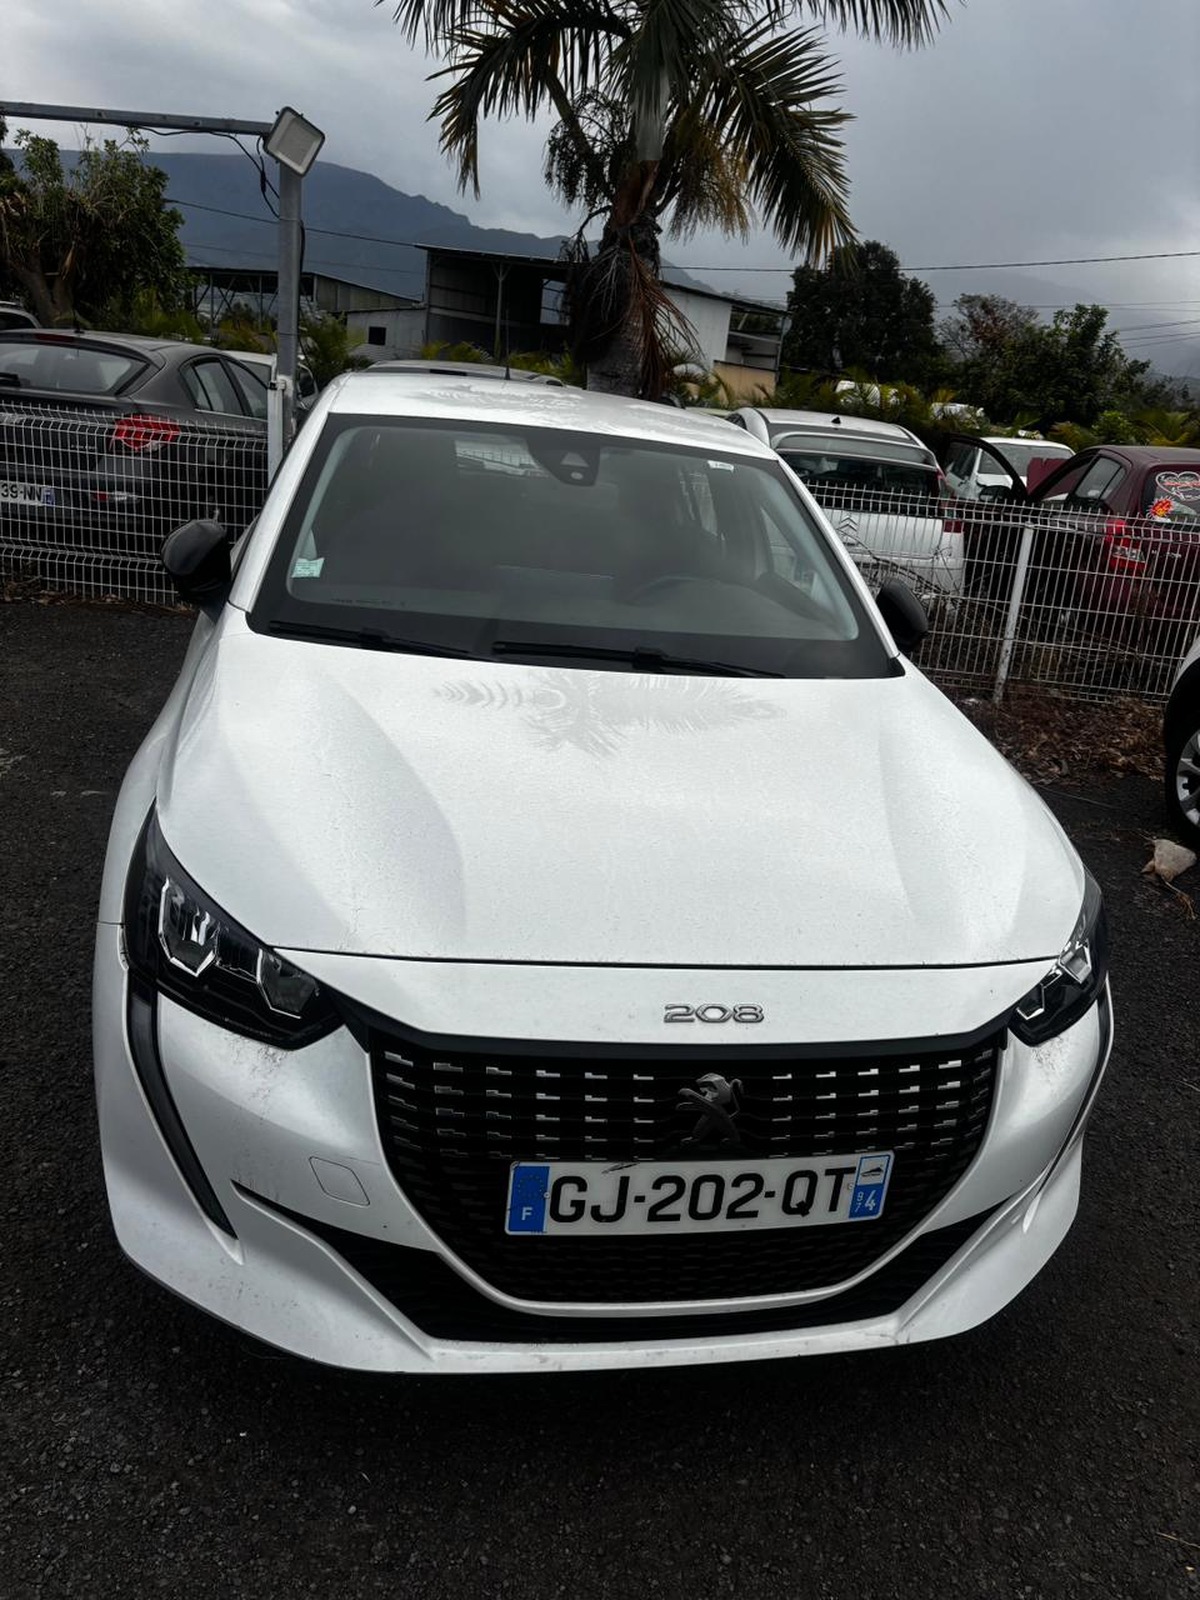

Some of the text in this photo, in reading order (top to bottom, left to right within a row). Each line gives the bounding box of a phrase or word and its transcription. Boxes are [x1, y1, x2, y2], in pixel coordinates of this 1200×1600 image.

[664, 1003, 764, 1023] 208
[549, 1166, 857, 1223] GJ-202-QT
[521, 1206, 533, 1221] F
